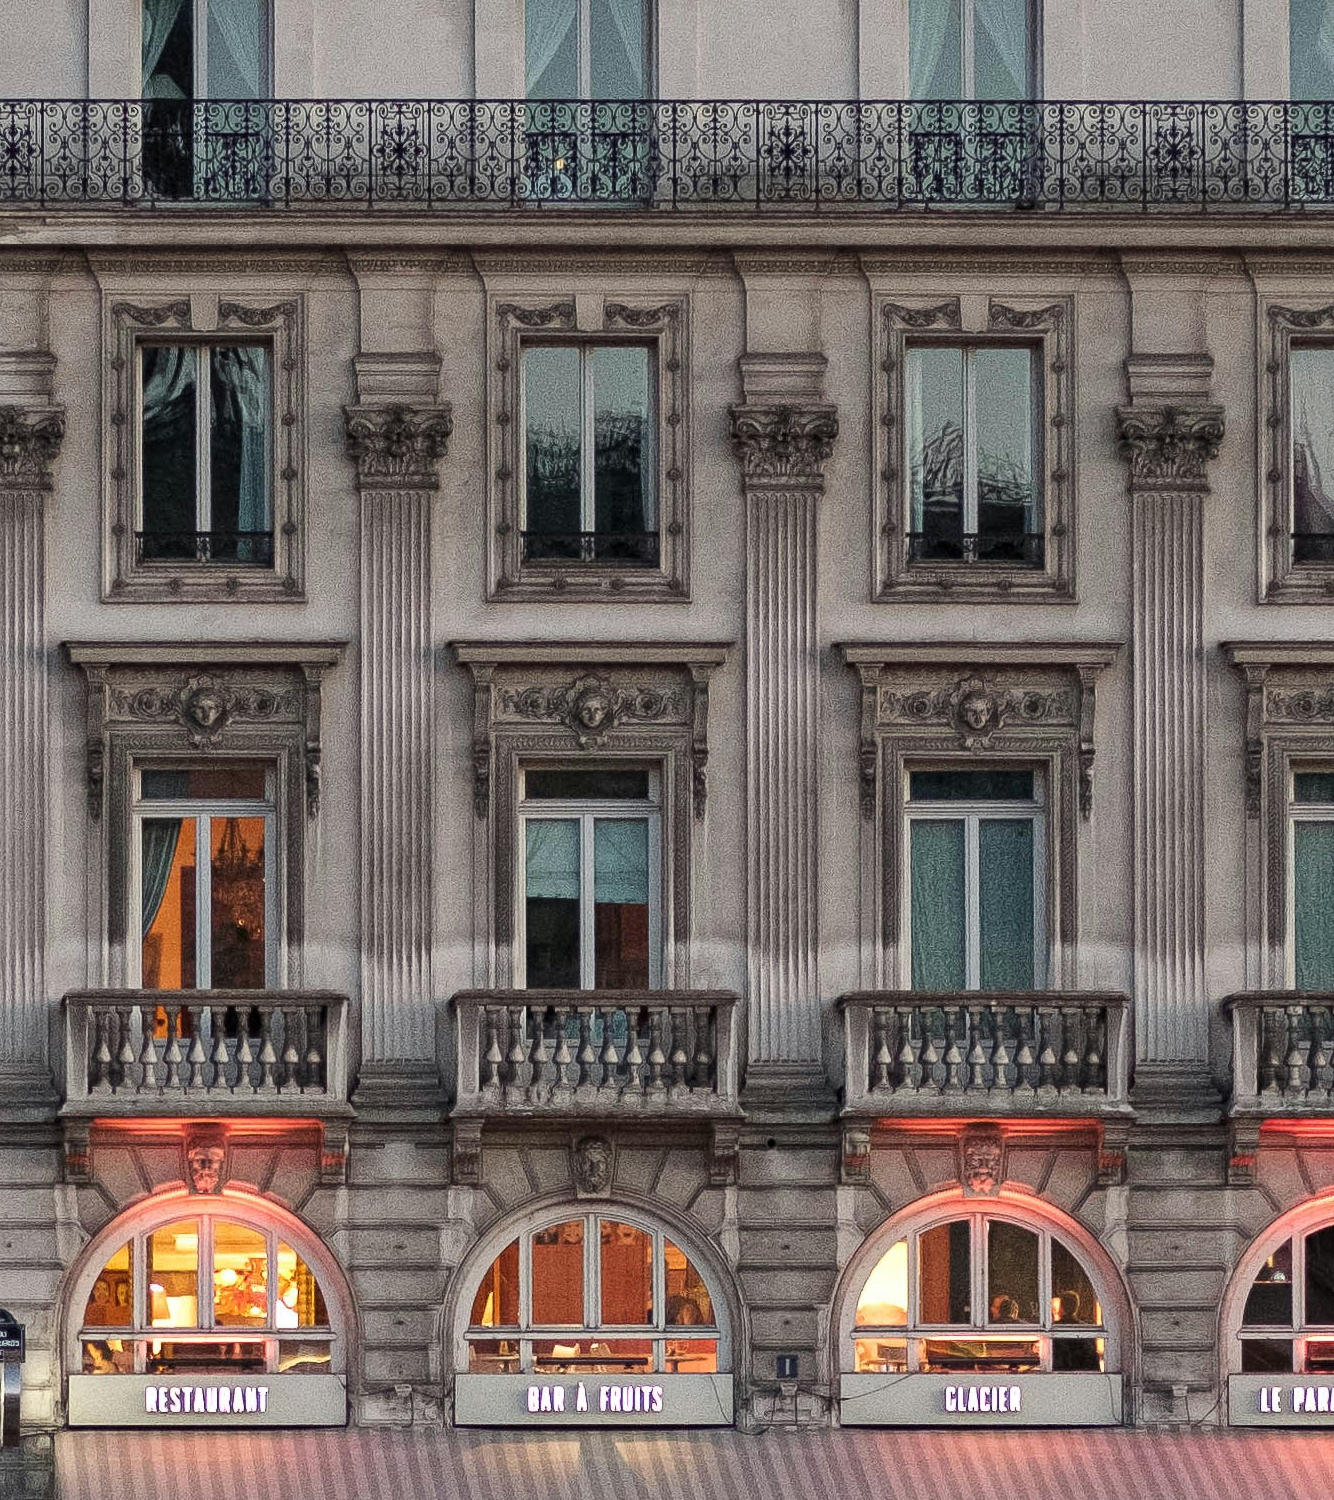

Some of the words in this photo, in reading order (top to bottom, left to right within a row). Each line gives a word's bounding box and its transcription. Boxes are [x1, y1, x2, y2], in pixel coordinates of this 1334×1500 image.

[145, 1386, 269, 1414] RESTAURANT
[528, 1386, 565, 1412] BAR
[576, 1381, 588, 1412] À
[599, 1386, 664, 1412] FRUITS
[945, 1385, 1022, 1413] GLACIER
[1260, 1386, 1282, 1413] LE
